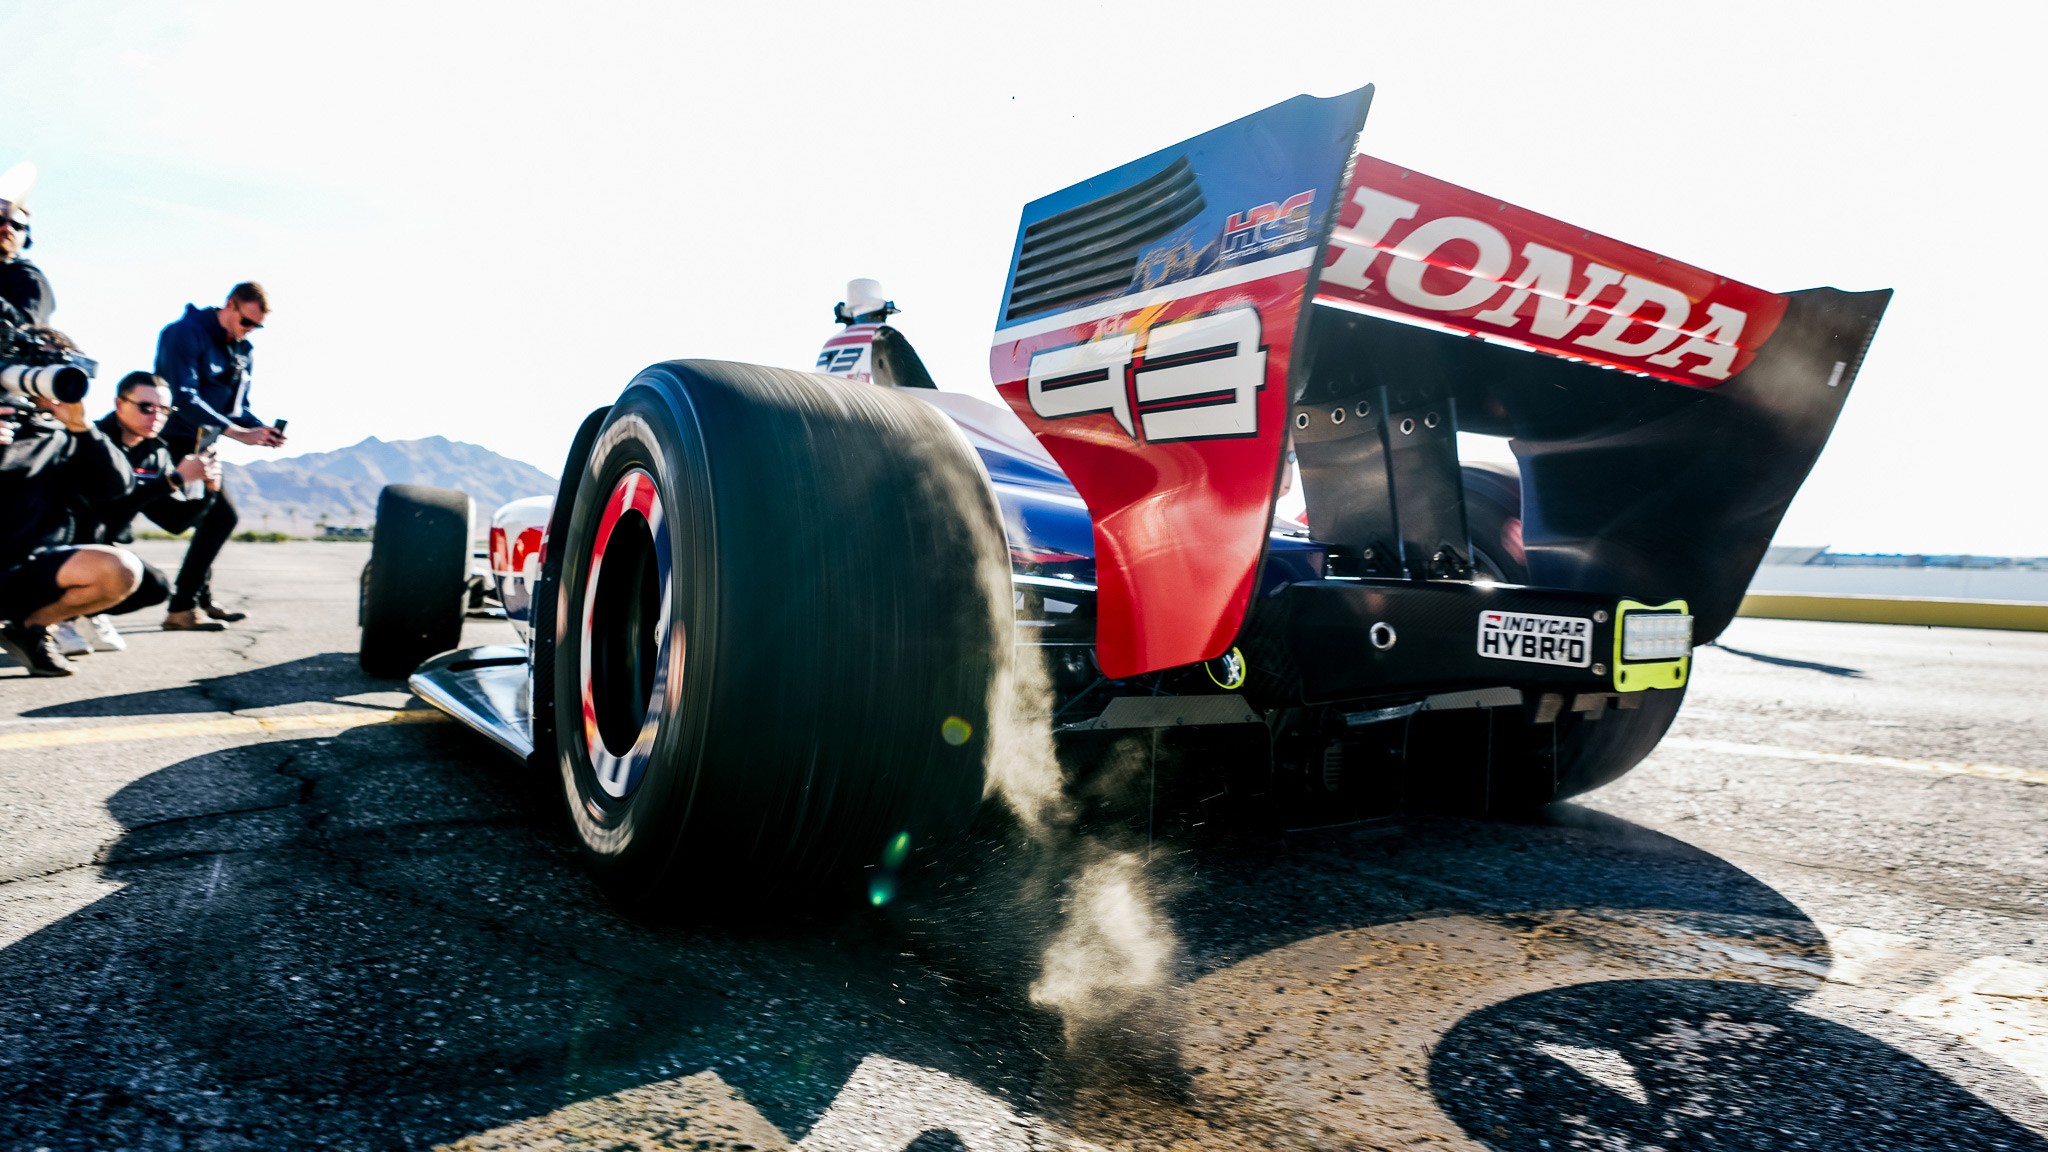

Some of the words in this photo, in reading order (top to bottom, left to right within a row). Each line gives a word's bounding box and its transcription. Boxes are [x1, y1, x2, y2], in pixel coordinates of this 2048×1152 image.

[1220, 188, 1316, 254] HRC
[1027, 303, 1269, 444] 93
[1483, 630, 1585, 663] HYBRID
[1503, 616, 1586, 637] INDYCAR
